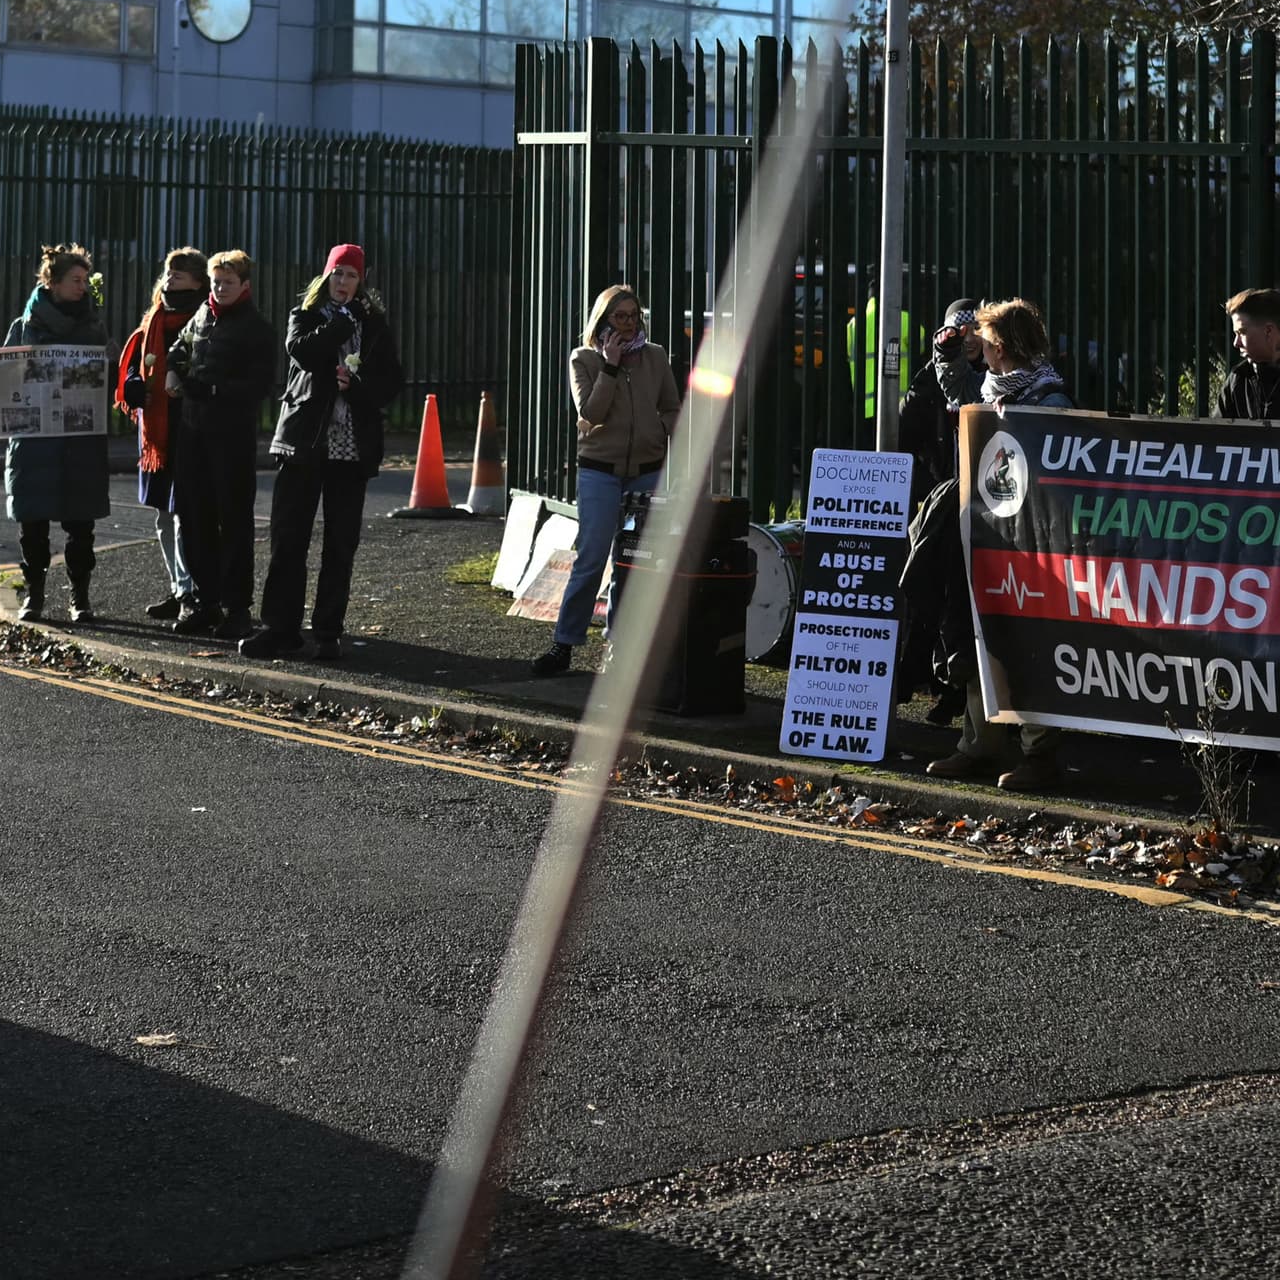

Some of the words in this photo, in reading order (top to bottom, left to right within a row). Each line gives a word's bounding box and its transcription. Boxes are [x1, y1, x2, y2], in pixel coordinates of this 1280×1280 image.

[0, 352, 18, 360] FREE
[23, 350, 37, 358] THE
[40, 350, 66, 358] FILTON
[69, 350, 79, 358] 24
[817, 453, 856, 465] RECENTLY
[858, 455, 908, 466] UNCOVERED
[1041, 433, 1103, 473] UK
[816, 466, 907, 484] DOCUMENTS
[843, 484, 876, 495] EXPOSE
[813, 497, 904, 516] POLITICAL
[810, 517, 903, 532] INTERFERENCE
[1071, 493, 1226, 545] HANDS
[838, 540, 856, 550] AND
[858, 540, 870, 550] AN
[819, 552, 885, 572] ABUSE
[837, 573, 864, 589] OF
[803, 590, 894, 612] PROCESS
[1064, 558, 1271, 630] HANDS
[799, 623, 890, 640] PROSECTIONS
[826, 641, 840, 651] OF
[842, 641, 860, 652] THE
[794, 654, 861, 675] FILTON
[868, 660, 887, 677] 18
[807, 679, 845, 692] SHOULD
[848, 682, 869, 693] NOT
[1054, 643, 1278, 713] SANCTION
[793, 695, 843, 708] CONTINUE
[845, 698, 878, 711] UNDER
[791, 710, 825, 727] THE
[830, 713, 877, 731] RULE
[789, 730, 816, 748] OF
[822, 733, 872, 754] LAW.
